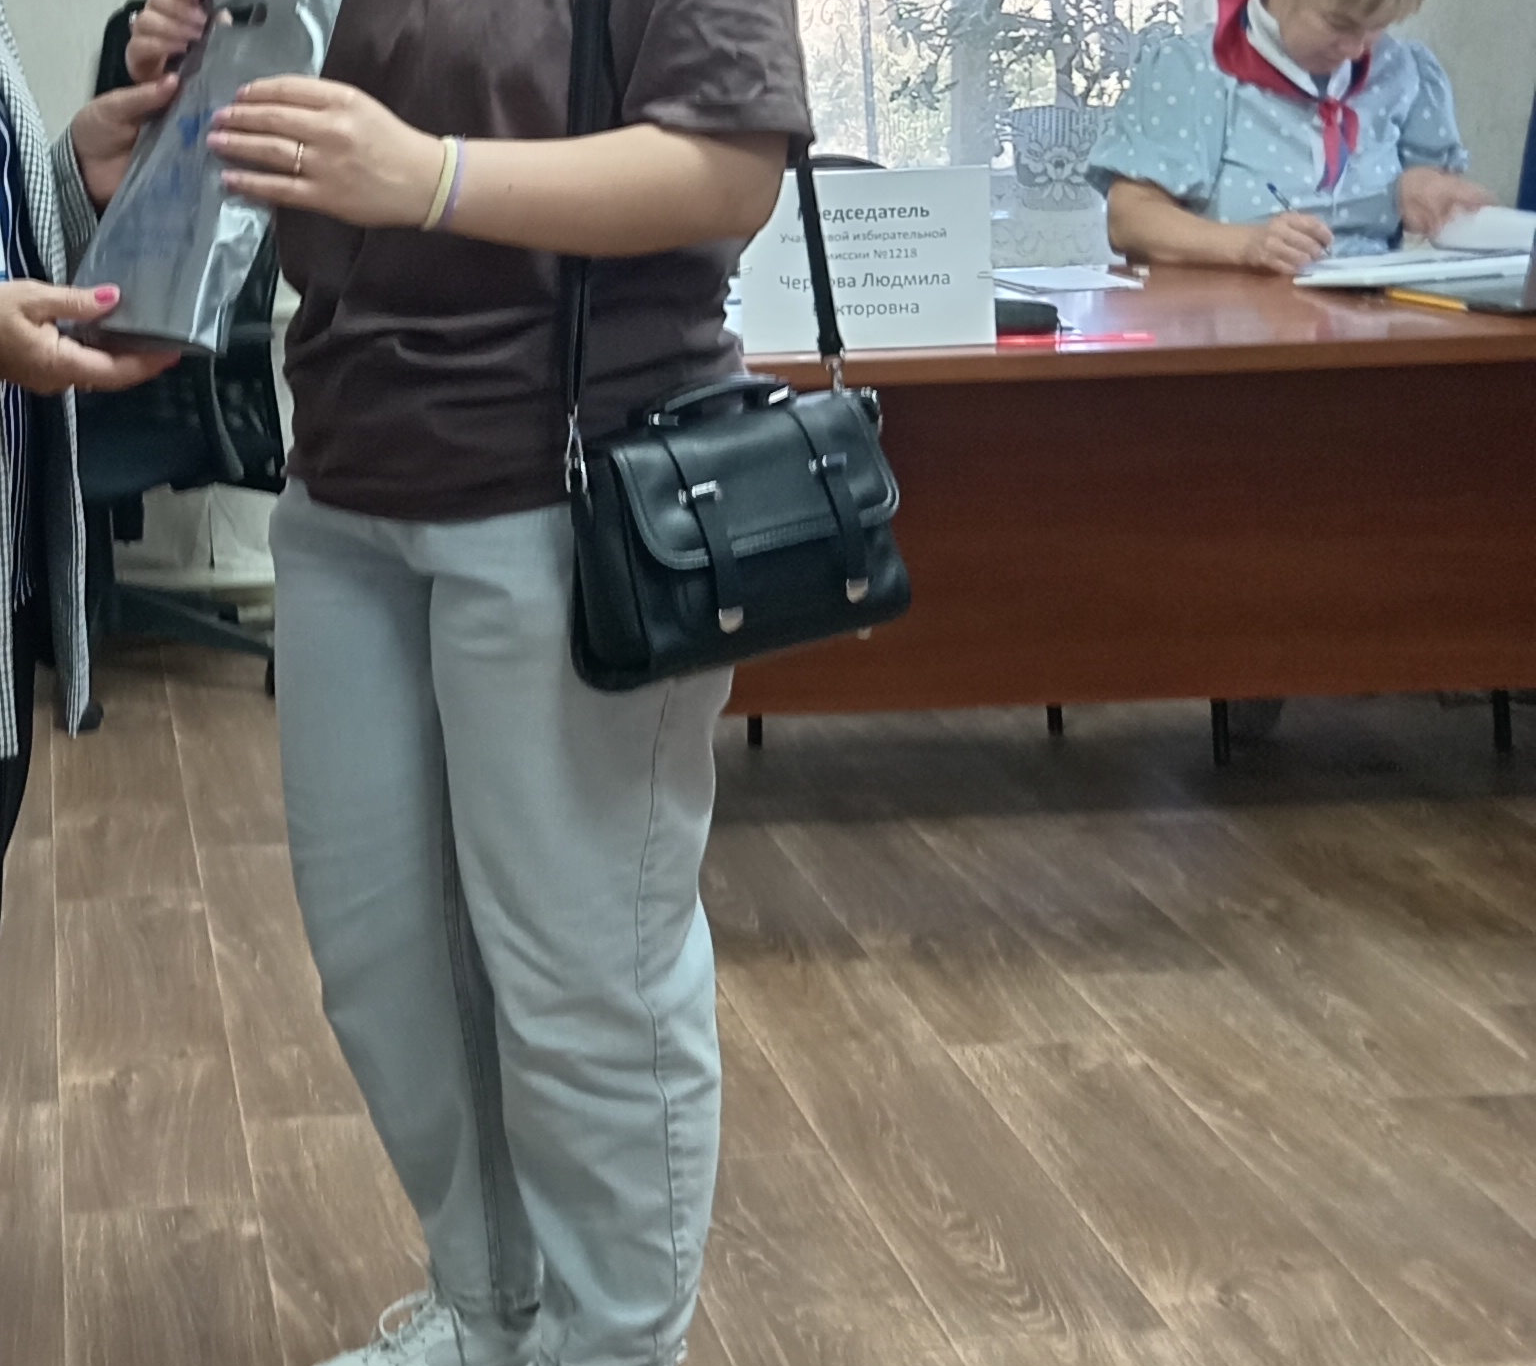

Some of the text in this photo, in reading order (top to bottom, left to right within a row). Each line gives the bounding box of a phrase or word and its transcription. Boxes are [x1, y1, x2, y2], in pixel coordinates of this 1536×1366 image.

[797, 206, 930, 223] едседатель
[853, 227, 947, 242] избирательной
[873, 247, 918, 260] №1218
[779, 272, 951, 292] Черва Людмила
[814, 302, 920, 318] кторовна
